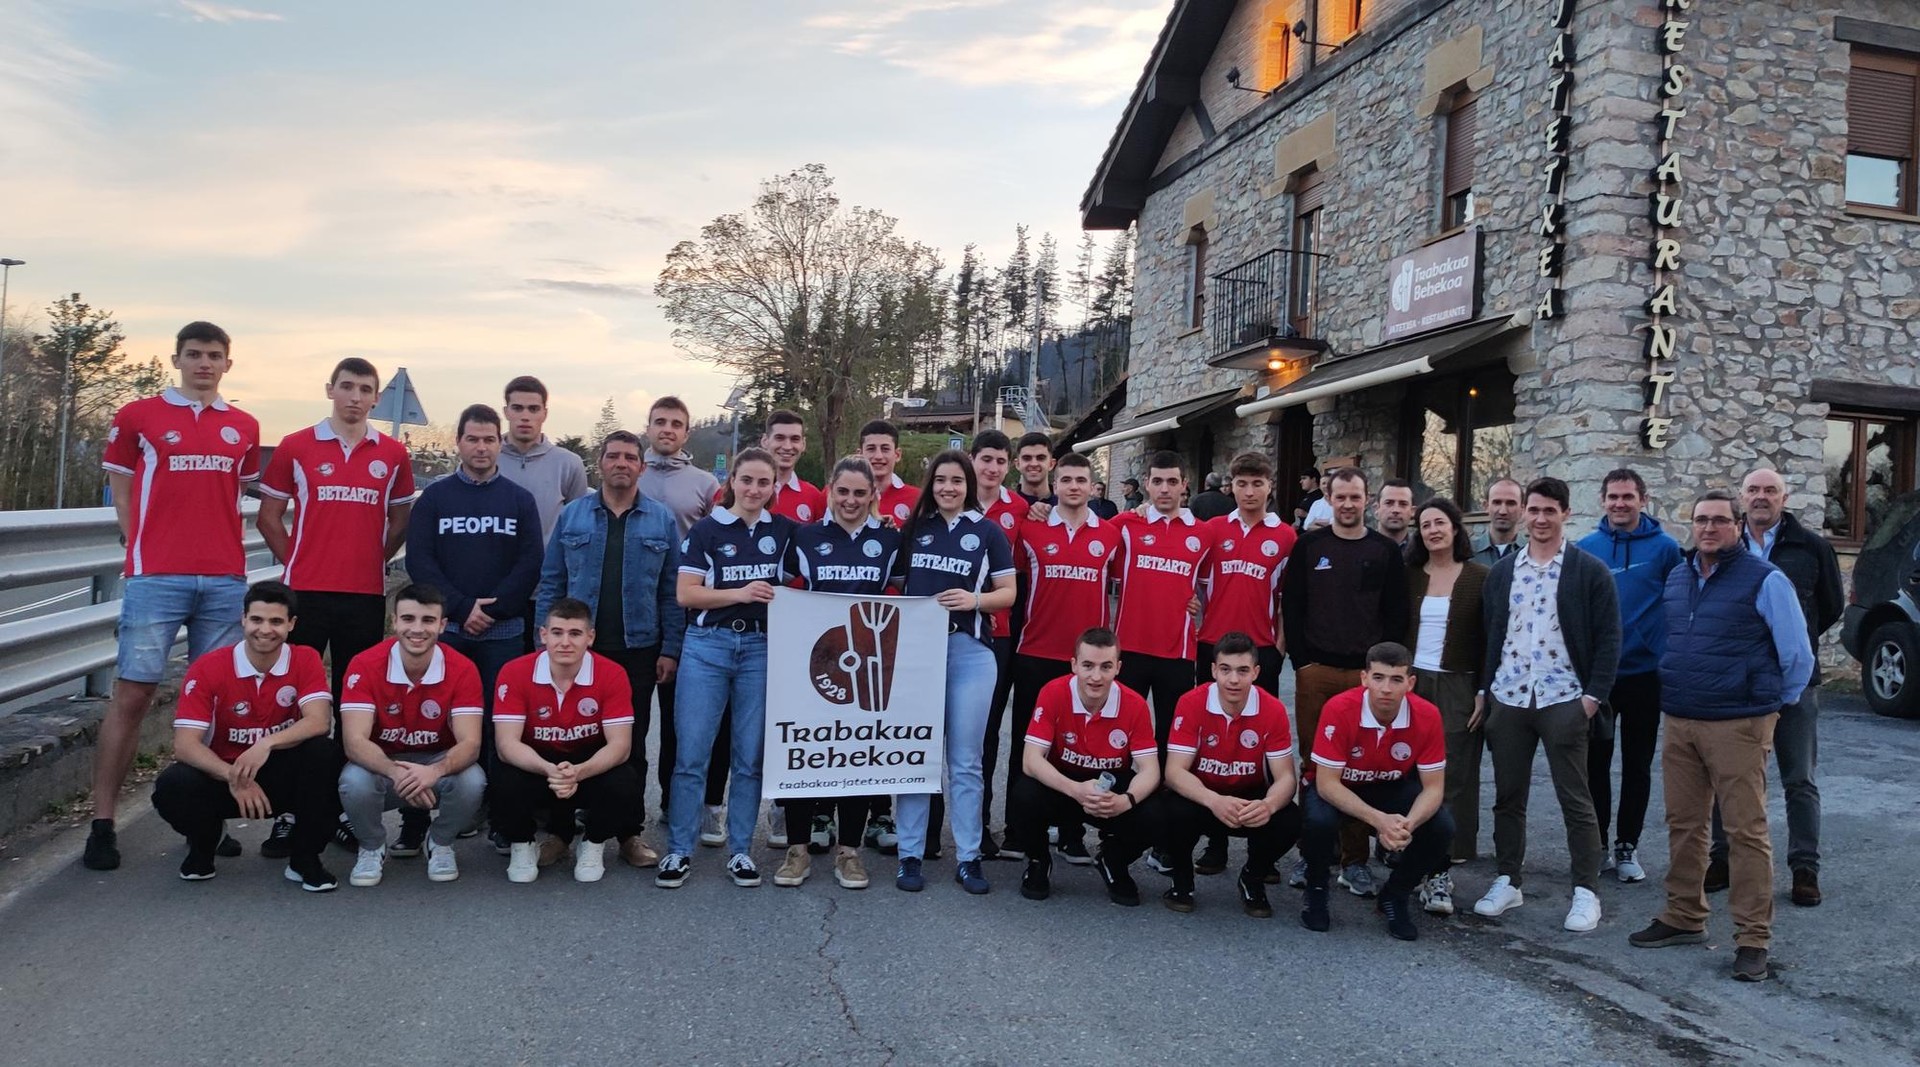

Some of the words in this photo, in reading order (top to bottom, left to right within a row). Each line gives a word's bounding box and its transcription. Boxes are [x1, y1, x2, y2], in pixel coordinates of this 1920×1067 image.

[1537, 0, 1565, 320] JATETXEA
[1647, 0, 1690, 449] ESTAURANTE
[1414, 256, 1469, 282] Trabakua
[1414, 276, 1463, 301] Behekoa
[169, 455, 234, 473] BETEARTE
[318, 486, 378, 505] BETEARTE
[438, 516, 517, 536] PEOPLE
[722, 563, 778, 581] BETEART
[817, 565, 881, 582] BETEARTE
[911, 553, 972, 577] BETEARTE
[1045, 564, 1098, 582] BETEARTE
[1137, 554, 1192, 577] BETEARTE
[815, 673, 847, 700] 1928
[534, 722, 599, 742] BETEARTE
[775, 719, 933, 743] Trabakua
[787, 746, 925, 770] Behekoa
[1061, 747, 1122, 769] BETEARTE
[1198, 757, 1256, 776] BETEARTE
[778, 776, 926, 790] trabakua-jatetxea.com
